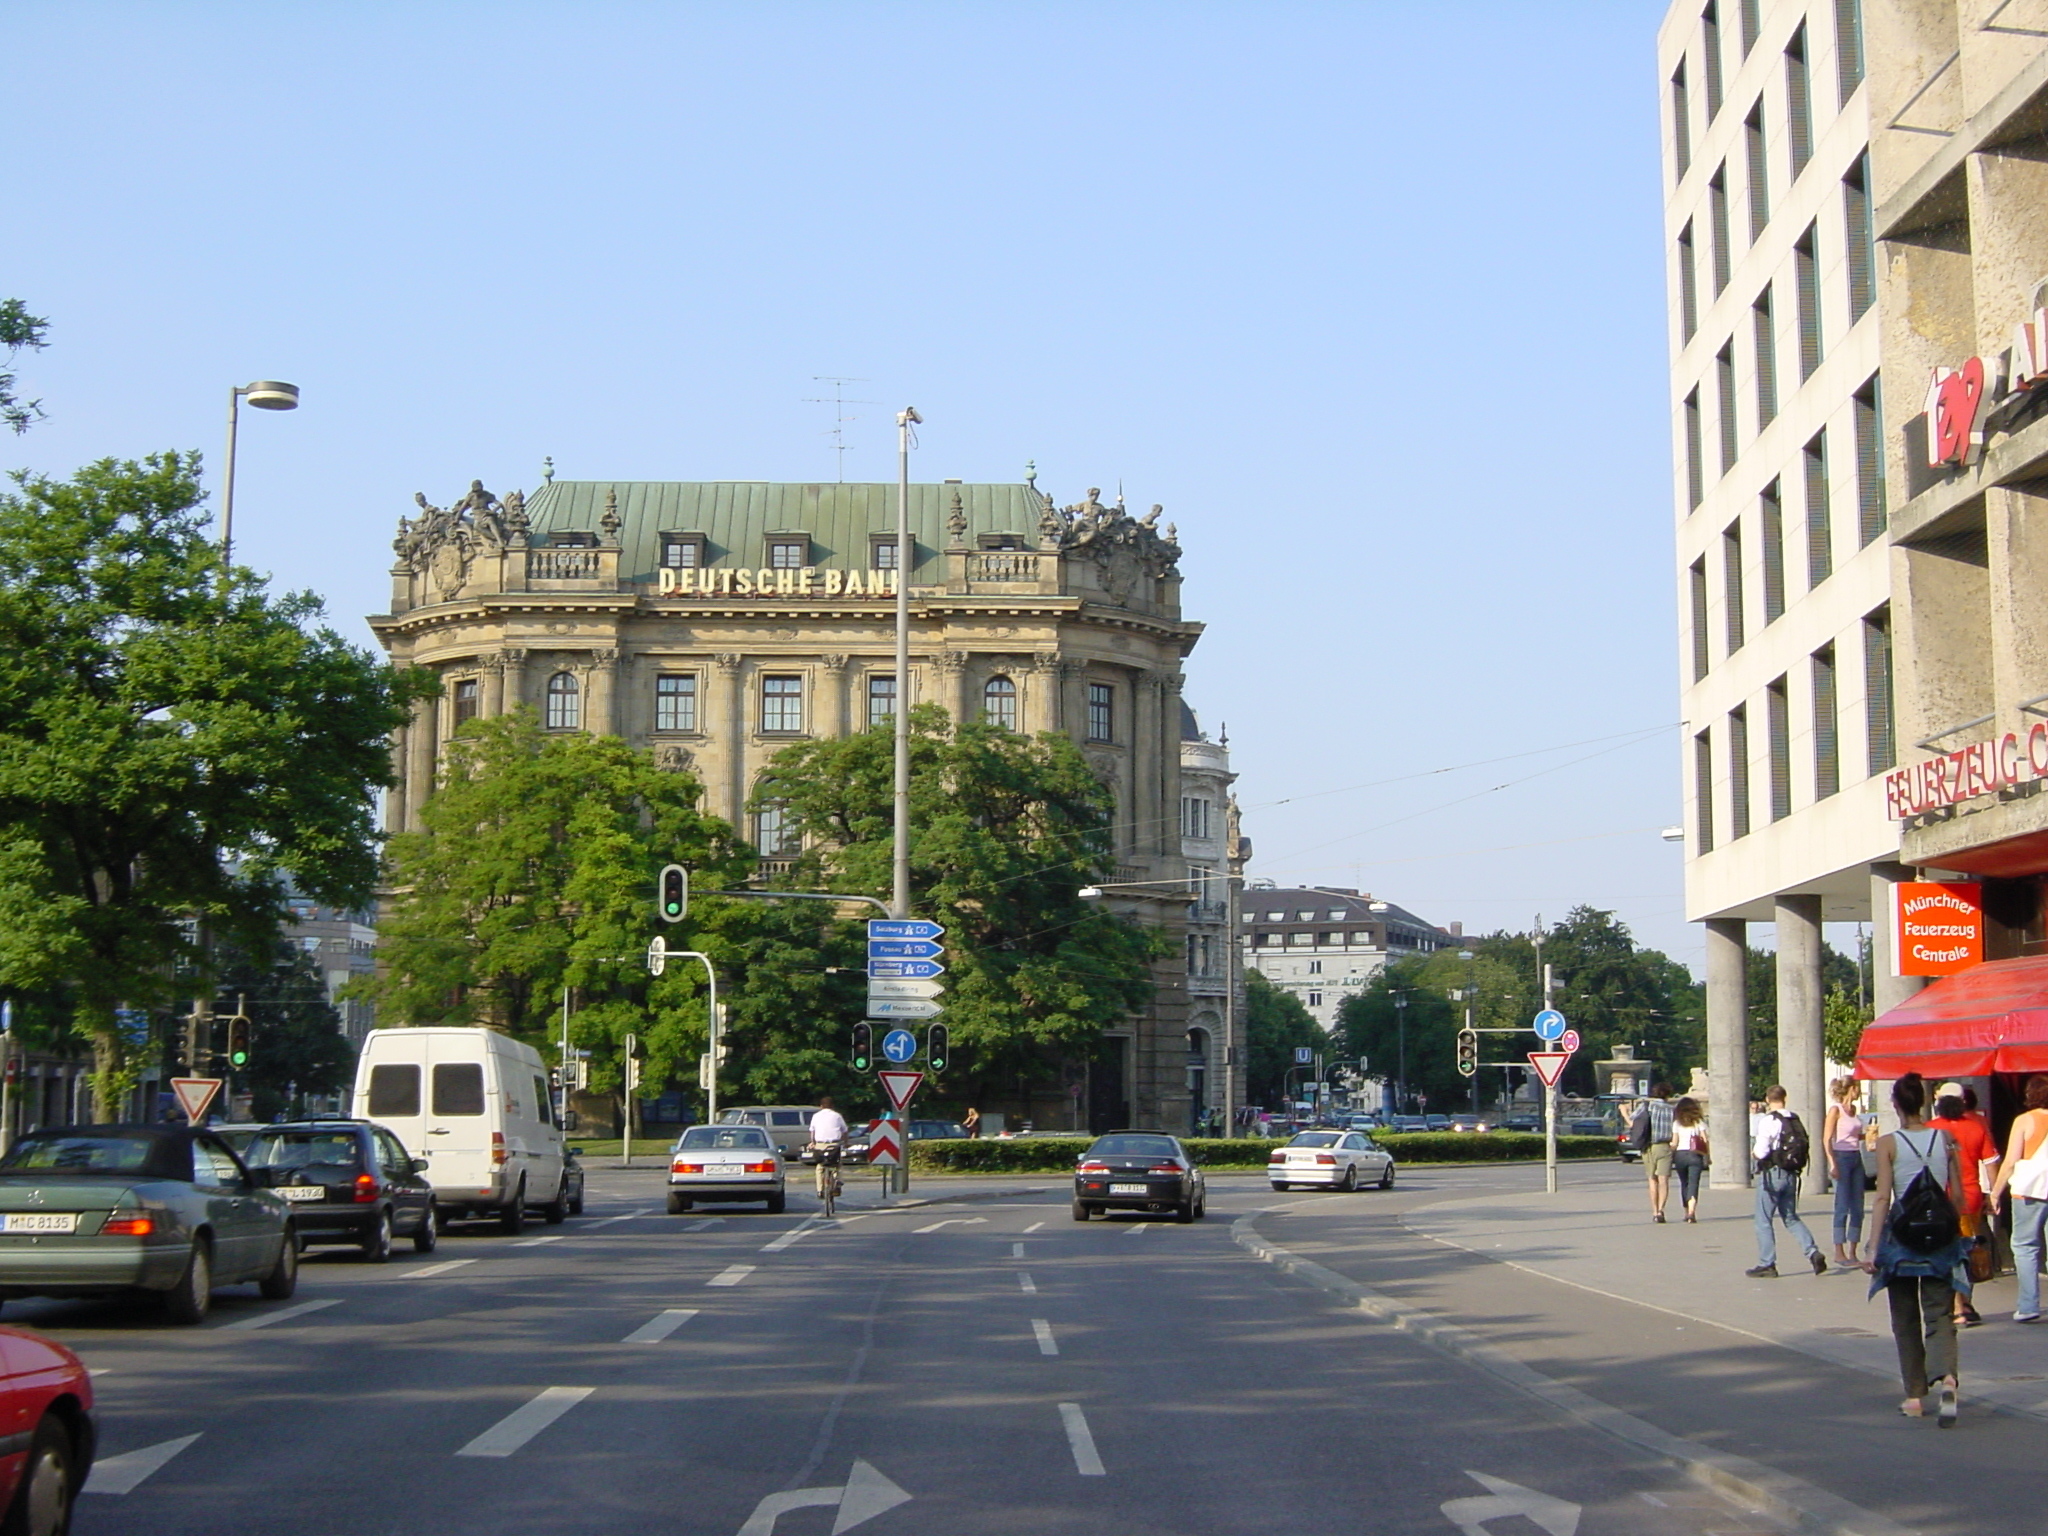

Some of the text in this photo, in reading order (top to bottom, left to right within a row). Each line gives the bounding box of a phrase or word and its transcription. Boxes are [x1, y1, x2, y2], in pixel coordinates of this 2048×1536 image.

[659, 567, 812, 594] DEUTSCHE
[1903, 893, 1975, 916] Münchner
[1904, 921, 1975, 939] Feuerzeug
[1912, 944, 1969, 963] Centrale
[1299, 1049, 1308, 1061] U
